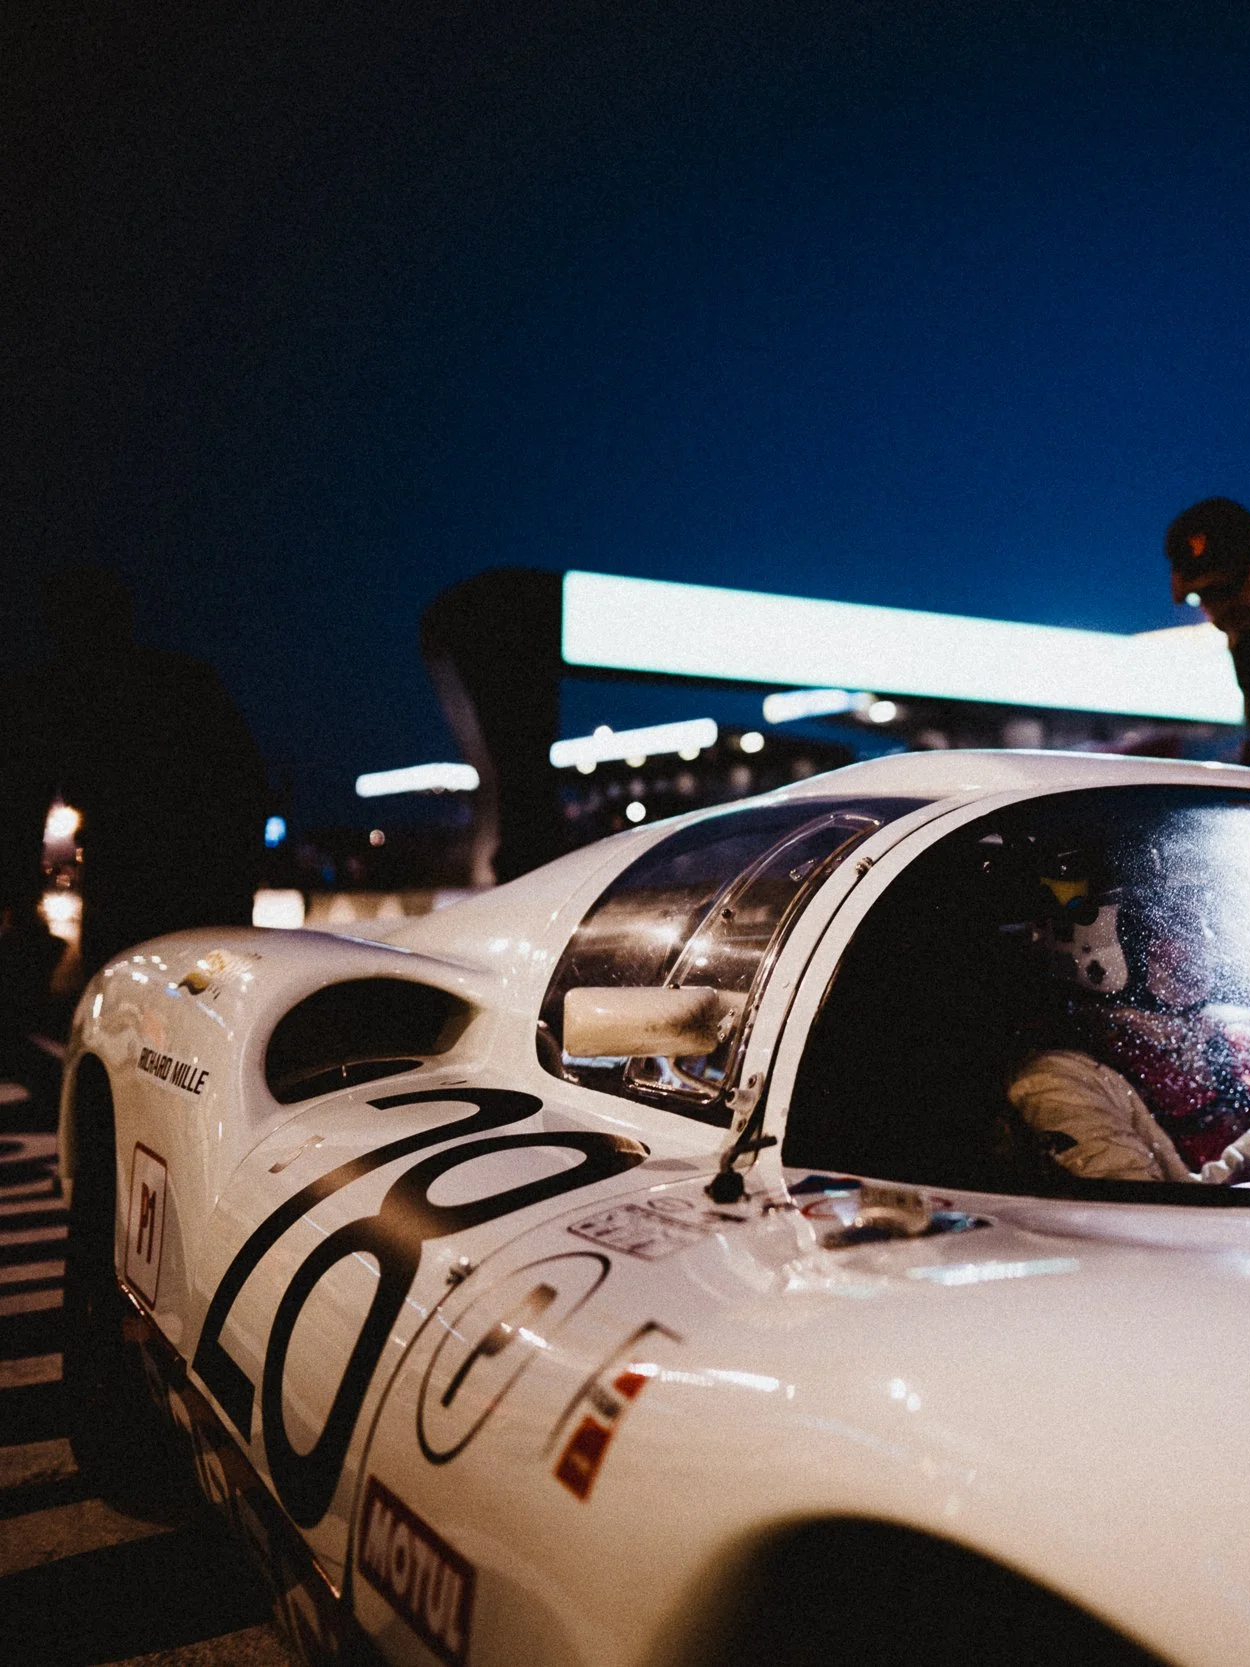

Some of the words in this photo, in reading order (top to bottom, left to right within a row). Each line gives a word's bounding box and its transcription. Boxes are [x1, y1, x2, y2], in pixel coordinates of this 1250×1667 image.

[137, 1046, 174, 1081] RICHARD
[169, 1060, 210, 1095] MILLE
[192, 1087, 652, 1530] 28
[365, 1496, 464, 1649] MOTUL
